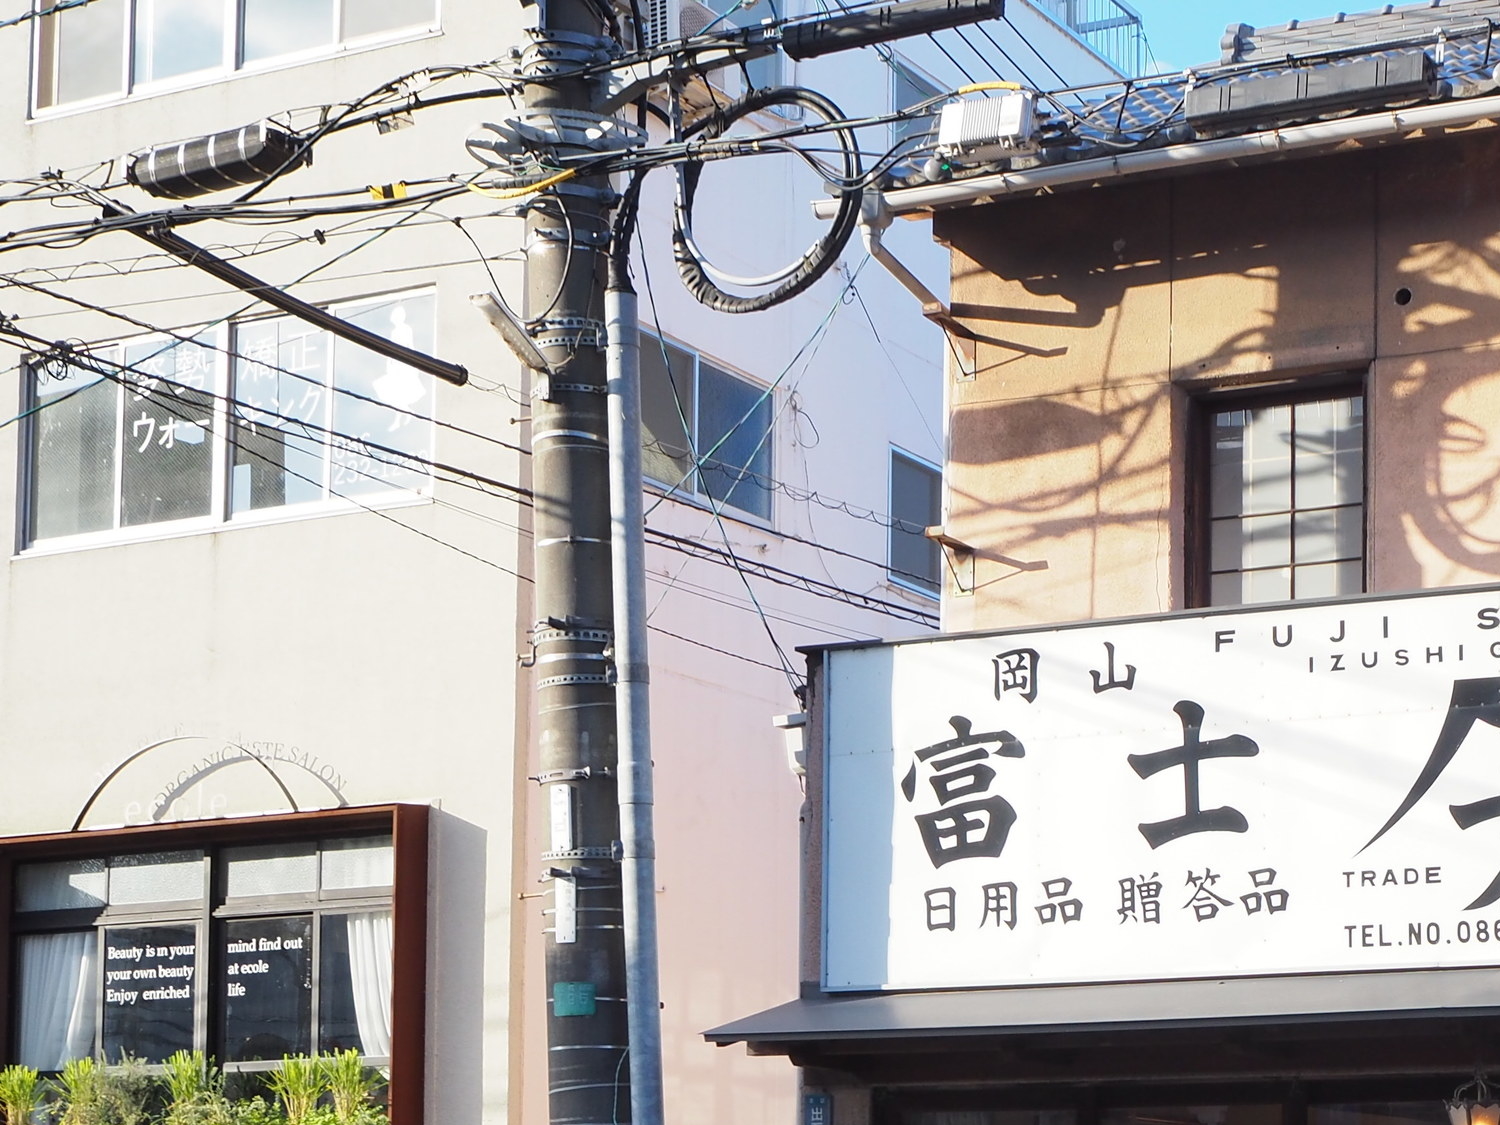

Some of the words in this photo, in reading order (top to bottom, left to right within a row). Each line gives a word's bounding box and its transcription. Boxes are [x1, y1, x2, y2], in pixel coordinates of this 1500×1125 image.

[1215, 615, 1391, 653] FUJI
[992, 641, 1137, 704] 岡山
[1308, 643, 1464, 673] IZUSHI
[901, 701, 1260, 869] 富士
[1342, 866, 1442, 888] TRADE
[925, 878, 1083, 932] 日用品
[1117, 867, 1289, 924] 贈答品
[108, 947, 143, 962] Beauty
[146, 945, 156, 958] is
[169, 944, 195, 962] your
[228, 938, 257, 953] mind
[259, 937, 282, 952] find
[283, 937, 304, 950] out
[106, 969, 132, 985] your
[133, 969, 158, 979] own
[158, 965, 194, 981] beauty
[228, 963, 240, 975] at
[241, 959, 270, 974] ecole
[106, 989, 138, 1006] Enjoy
[143, 985, 190, 1000] enriched
[228, 983, 246, 997] life
